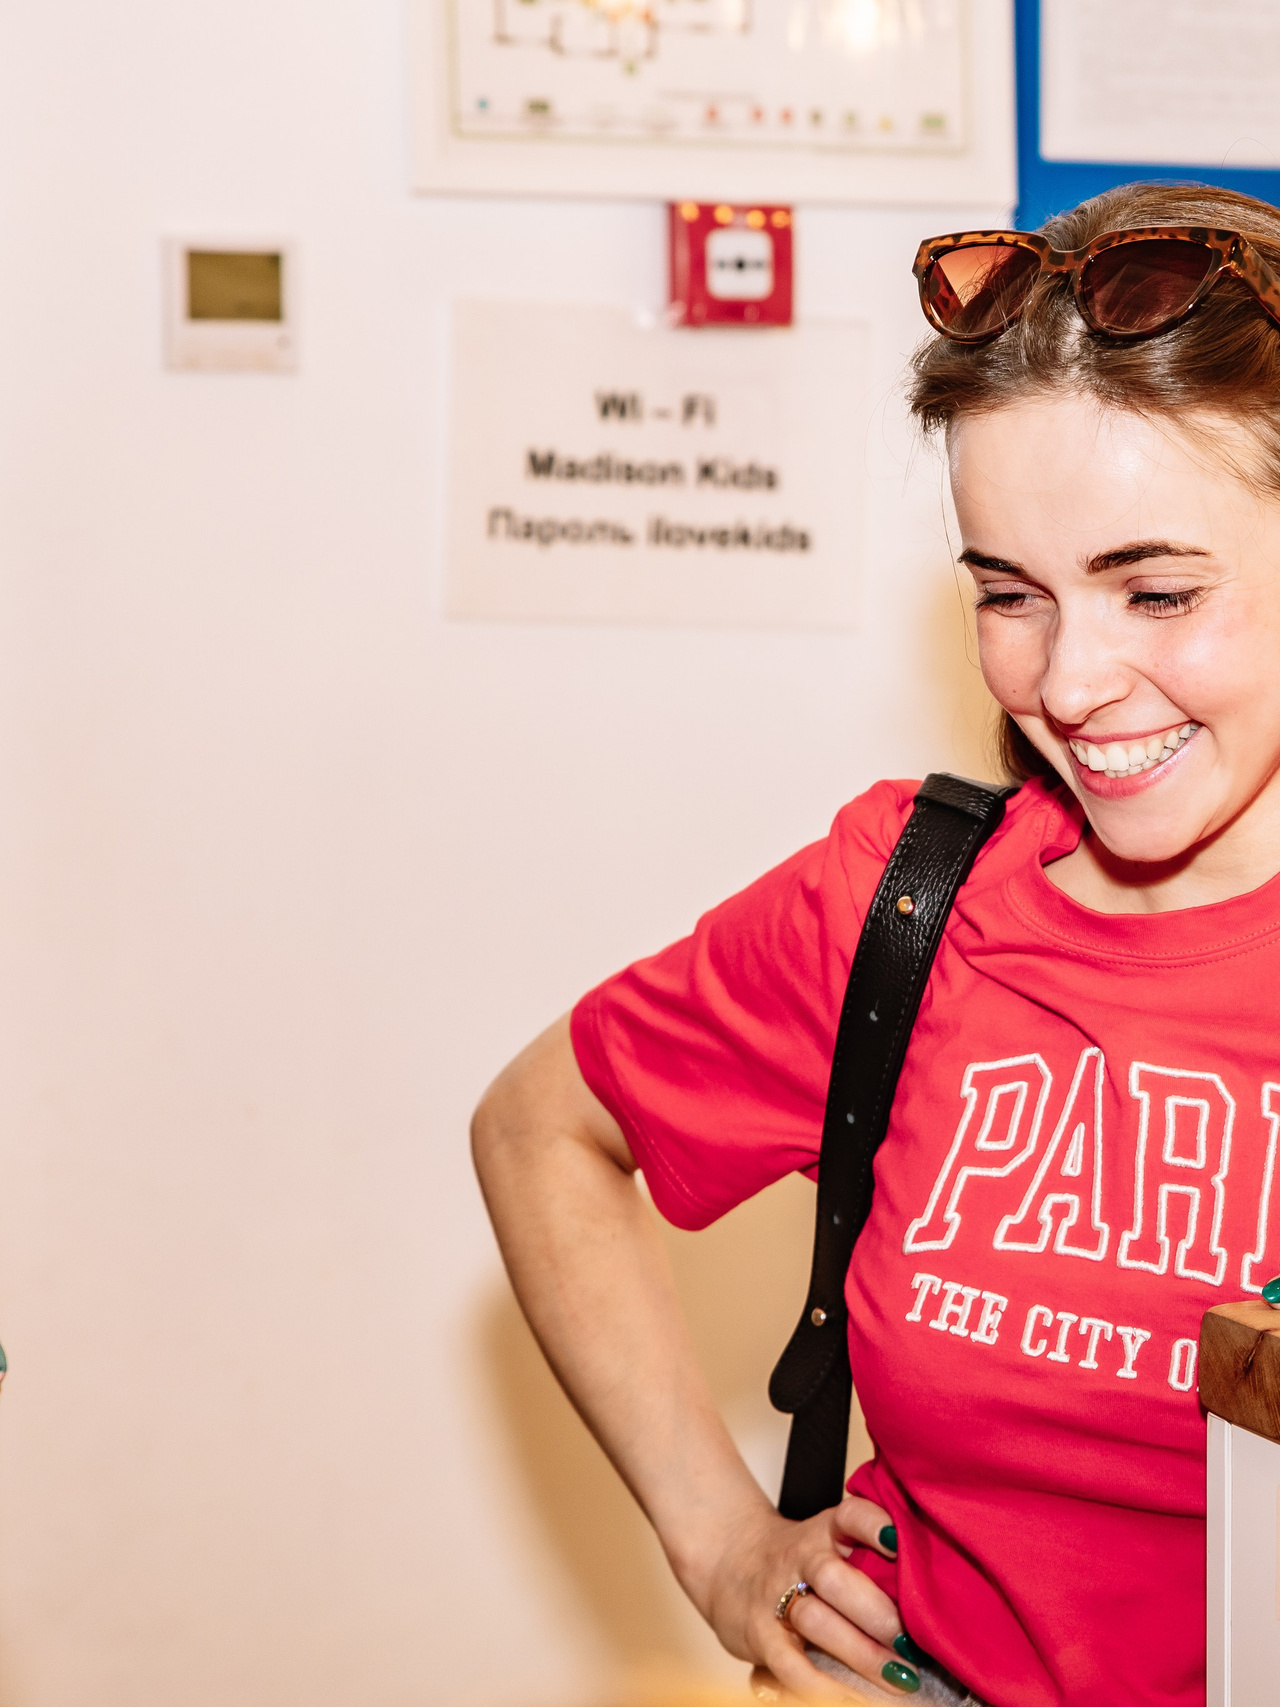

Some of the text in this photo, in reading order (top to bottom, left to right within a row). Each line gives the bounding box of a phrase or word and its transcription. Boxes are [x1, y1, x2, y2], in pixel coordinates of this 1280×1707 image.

[526, 447, 777, 490] Madison Kids
[905, 1272, 1200, 1392] THE CITY O
